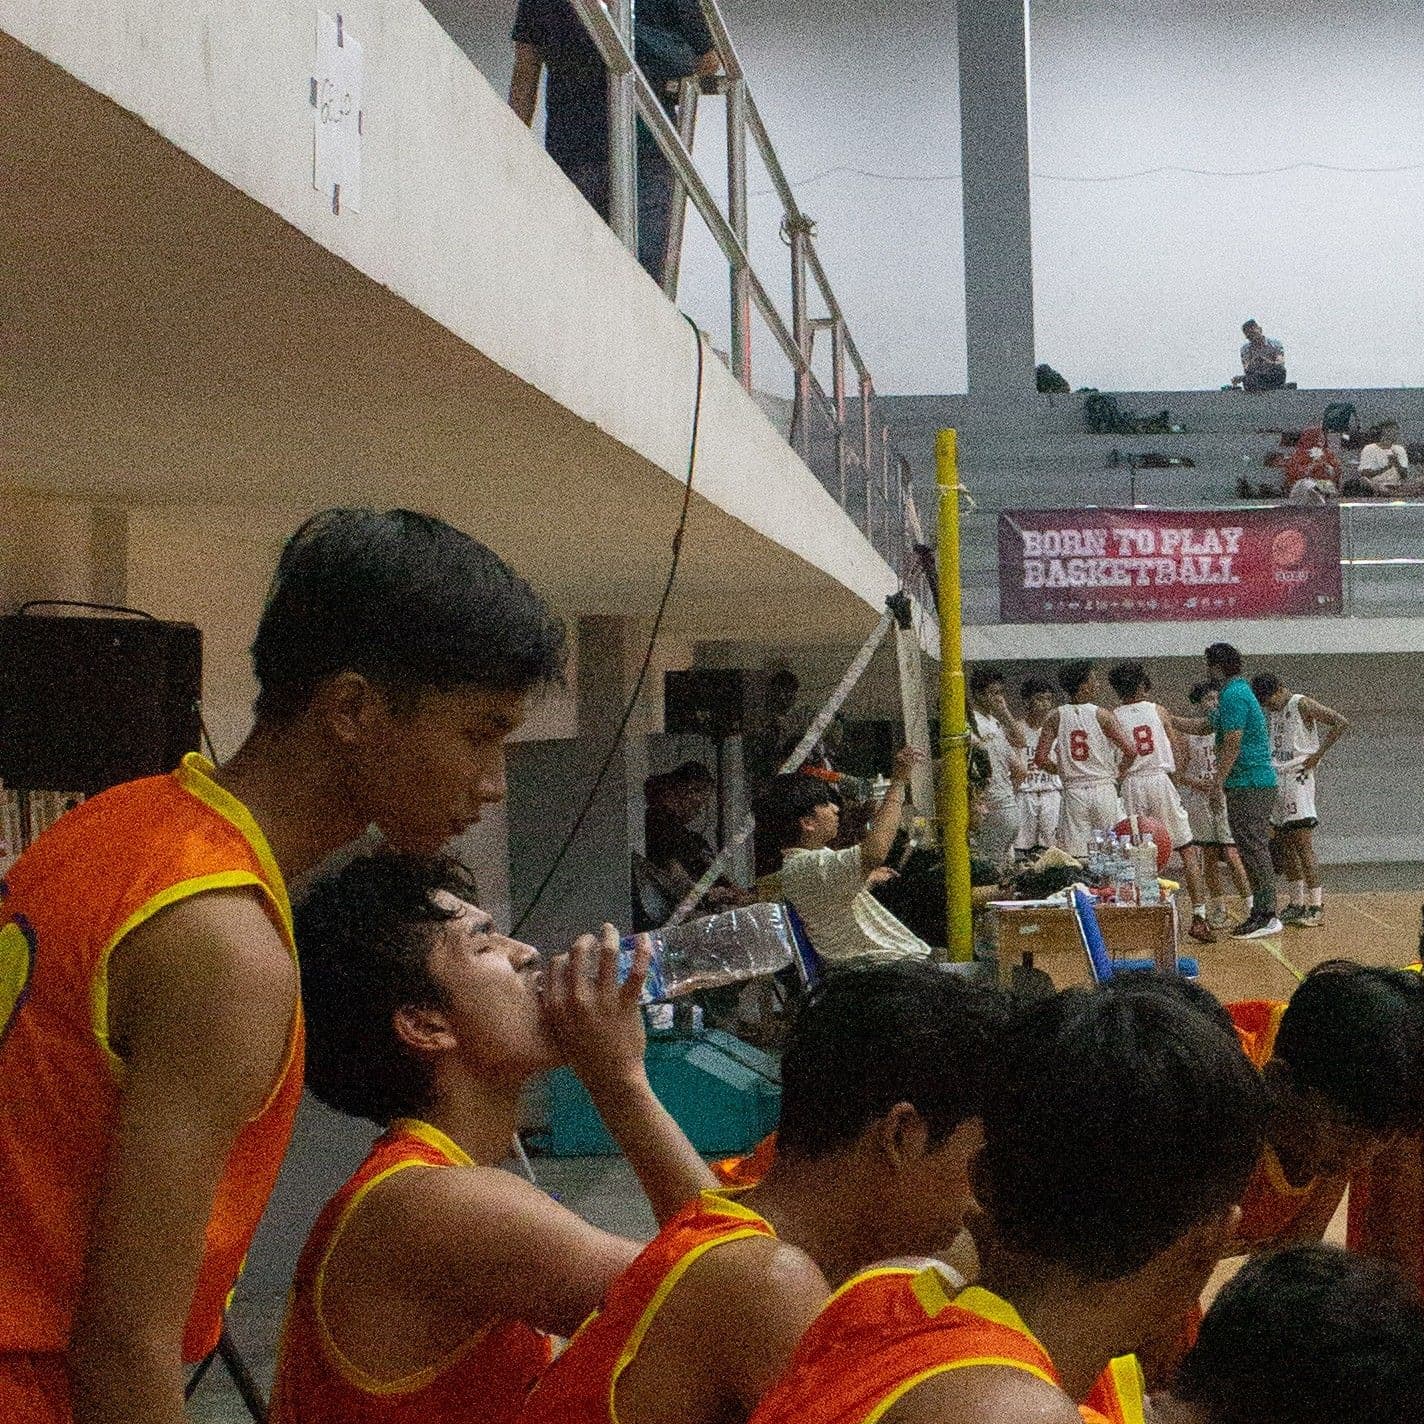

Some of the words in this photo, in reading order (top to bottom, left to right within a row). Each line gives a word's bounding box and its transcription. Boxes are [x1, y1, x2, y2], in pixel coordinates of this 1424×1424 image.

[1022, 530, 1106, 557] BORN
[1113, 528, 1157, 556] TO
[1160, 526, 1244, 555] PLAY
[1023, 556, 1241, 588] BASKETBALL
[1070, 729, 1090, 762] 6
[1133, 724, 1155, 756] 8
